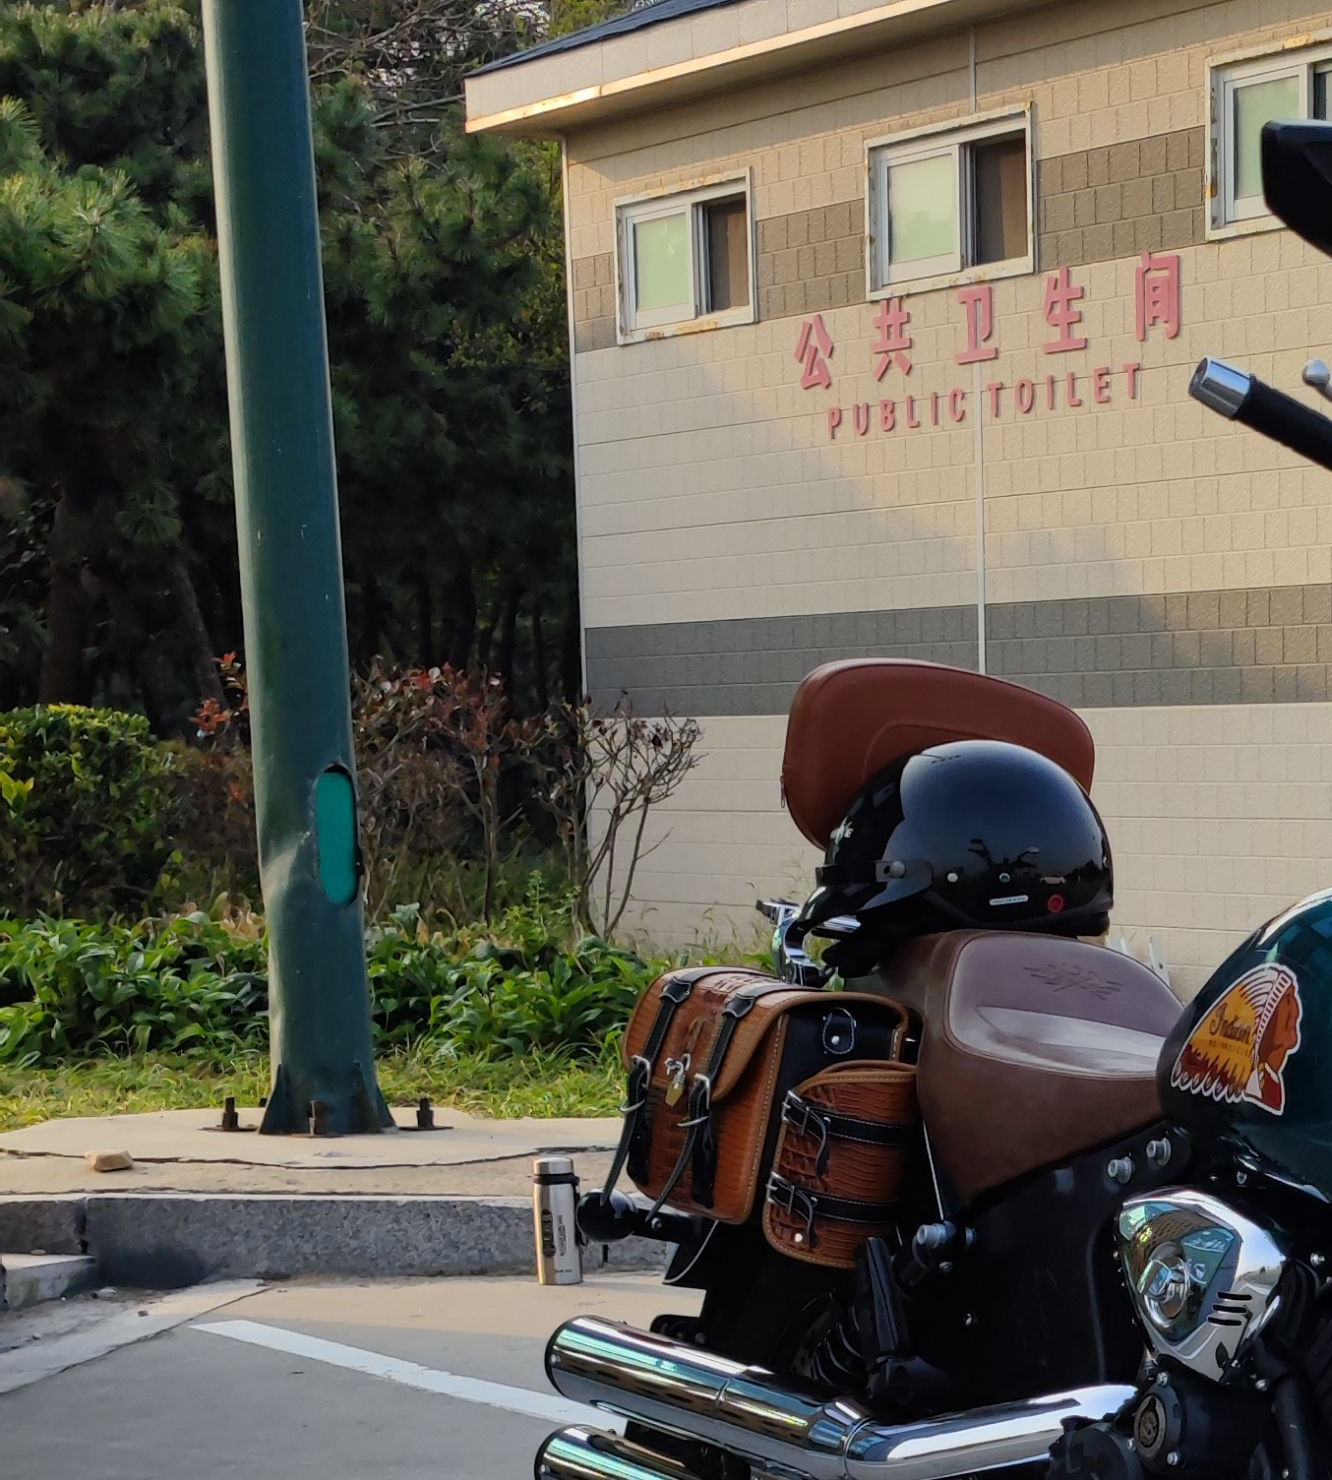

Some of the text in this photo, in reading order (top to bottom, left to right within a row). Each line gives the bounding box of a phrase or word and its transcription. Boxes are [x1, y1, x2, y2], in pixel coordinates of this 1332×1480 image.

[794, 250, 1183, 390] 公共卫生间
[827, 362, 1142, 440] PUBLIC TOILET
